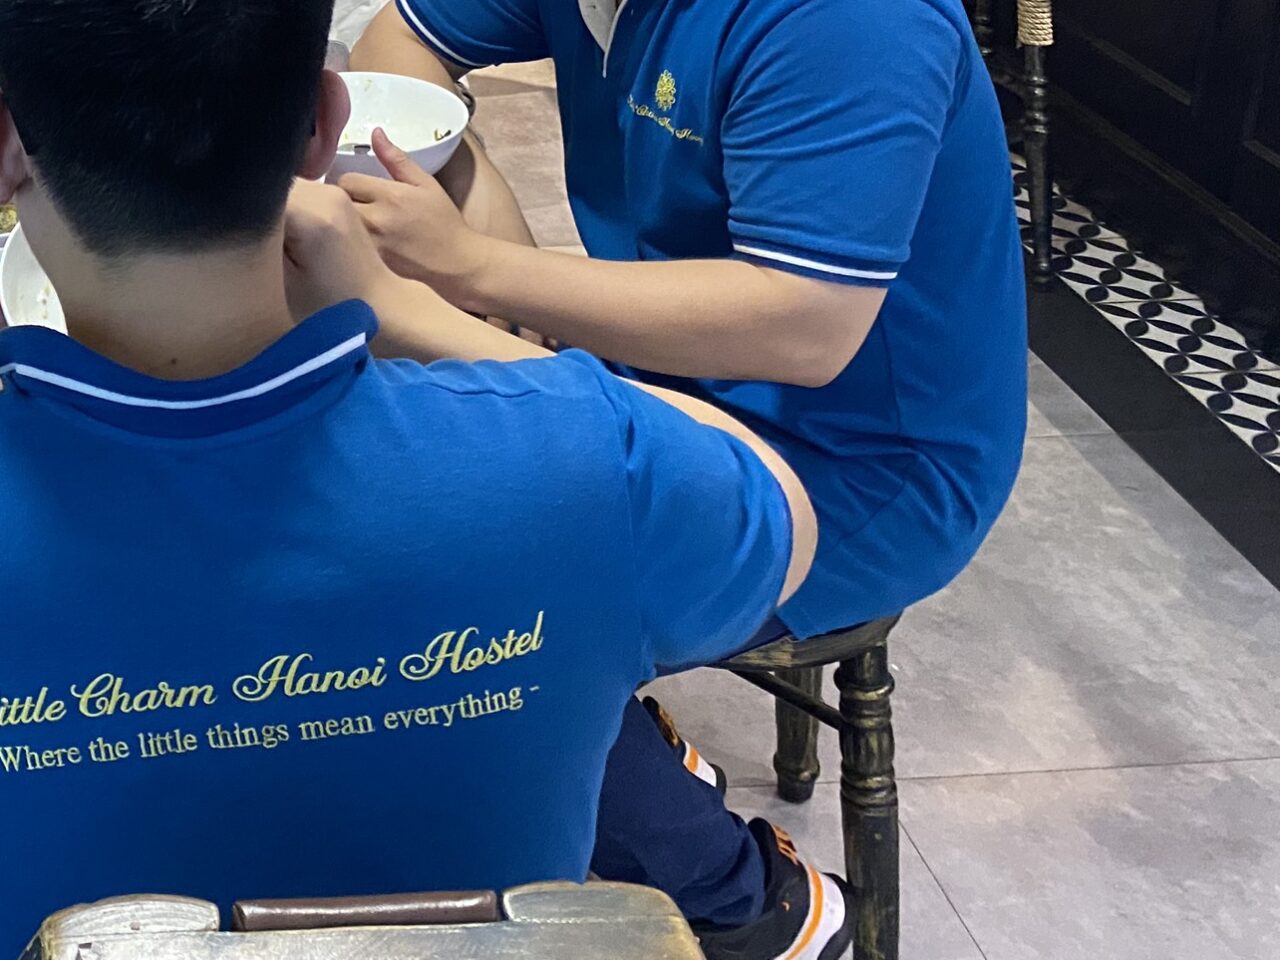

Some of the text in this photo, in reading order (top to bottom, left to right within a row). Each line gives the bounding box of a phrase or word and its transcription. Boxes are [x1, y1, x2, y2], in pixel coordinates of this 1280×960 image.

[70, 673, 219, 718] Charm
[231, 653, 388, 702] Hanoi
[399, 610, 544, 682] Hostel
[88, 737, 130, 763] the
[137, 728, 198, 759] little
[206, 722, 290, 749] things
[298, 714, 375, 741] mean
[383, 686, 524, 730] everything
